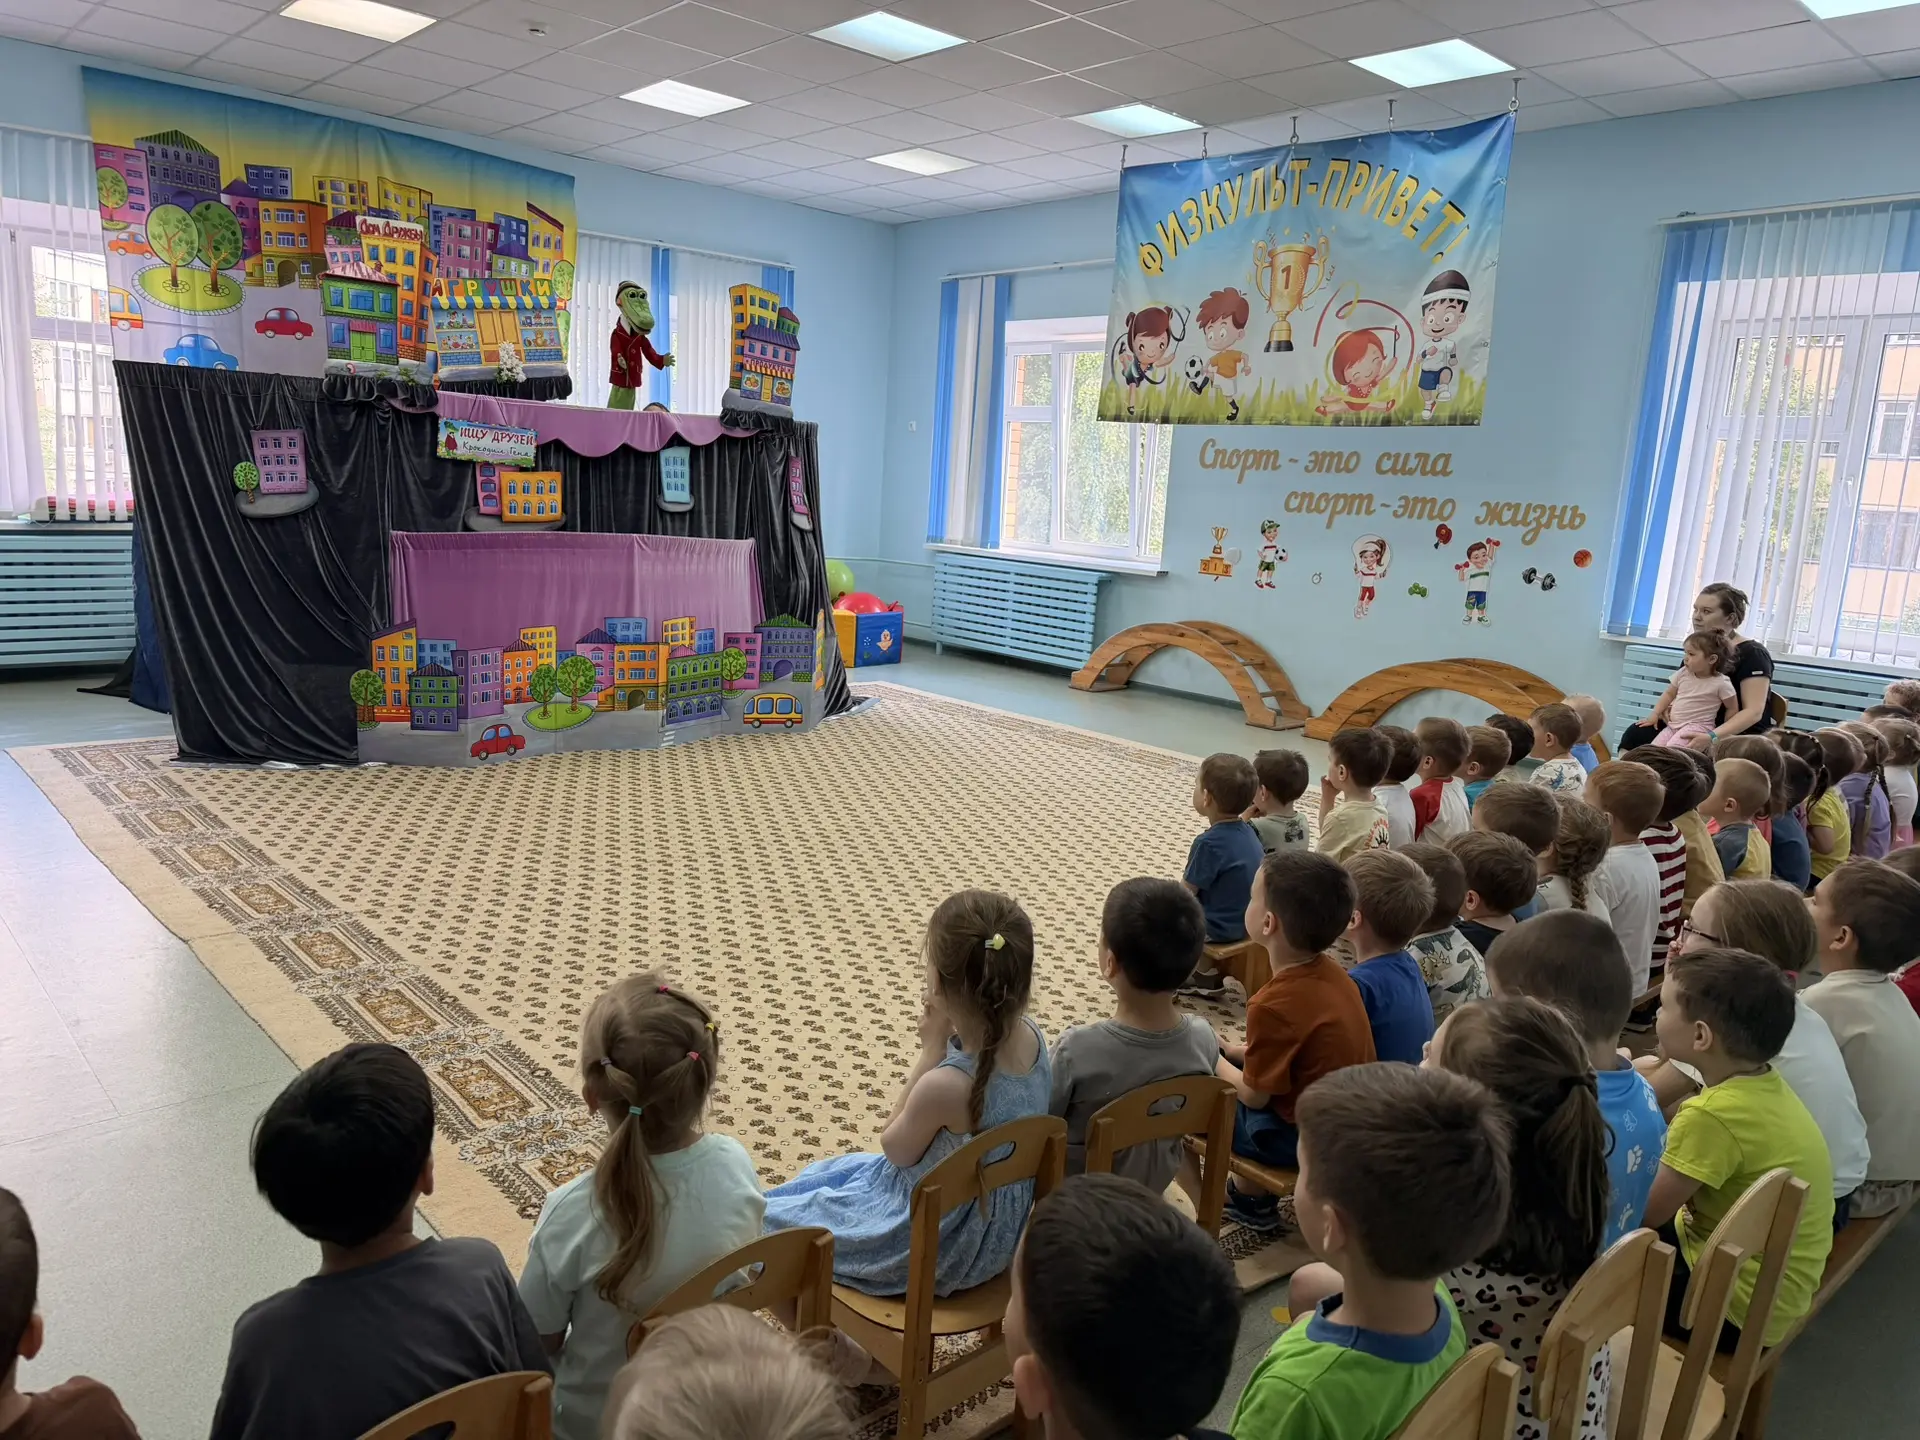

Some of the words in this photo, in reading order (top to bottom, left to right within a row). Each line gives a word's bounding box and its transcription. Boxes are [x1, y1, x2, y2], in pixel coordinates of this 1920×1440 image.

[1138, 157, 1470, 276] ФИЗКУЛЬТ-ПРИВЕТ!
[1281, 265, 1291, 290] 1
[460, 427, 488, 441] ИЩУ
[491, 431, 534, 445] ДРУЗЕЙ
[462, 441, 505, 456] Крокодил
[509, 446, 532, 457] Гена
[1199, 437, 1281, 484] Спорт
[1304, 448, 1361, 474] это
[1375, 450, 1453, 477] сила
[1475, 500, 1587, 546] жизнь
